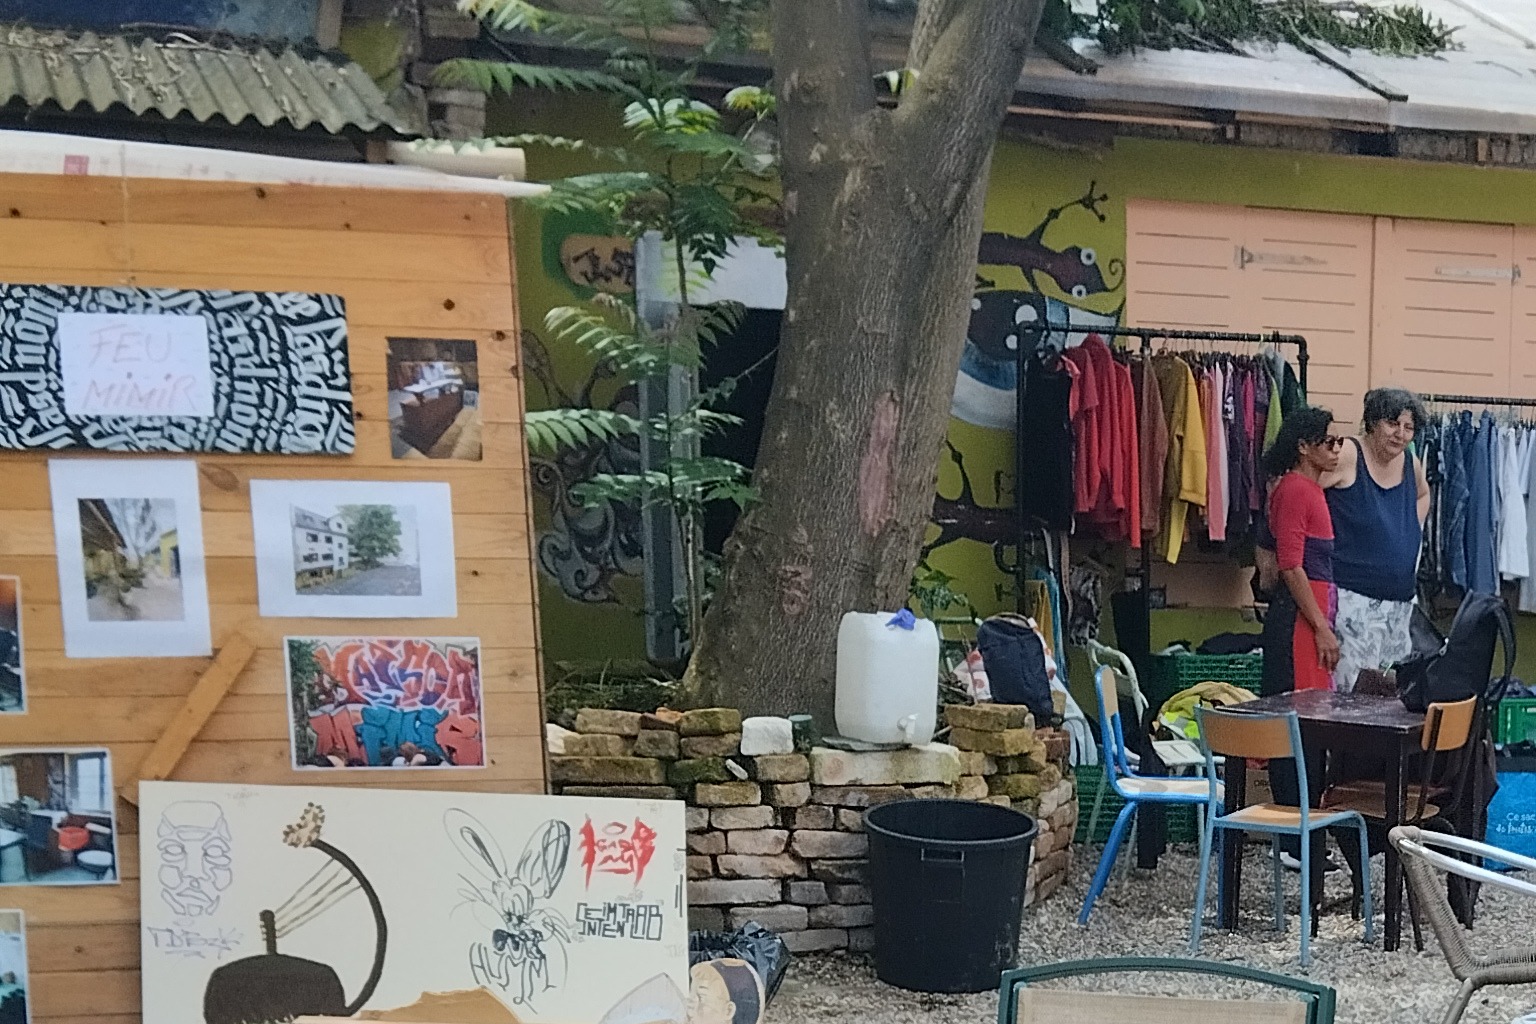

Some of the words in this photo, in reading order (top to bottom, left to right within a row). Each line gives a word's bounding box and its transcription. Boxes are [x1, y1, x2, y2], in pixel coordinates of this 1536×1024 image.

[89, 323, 174, 367] FEU
[1506, 812, 1520, 821] Ce
[1521, 813, 1536, 821] sac
